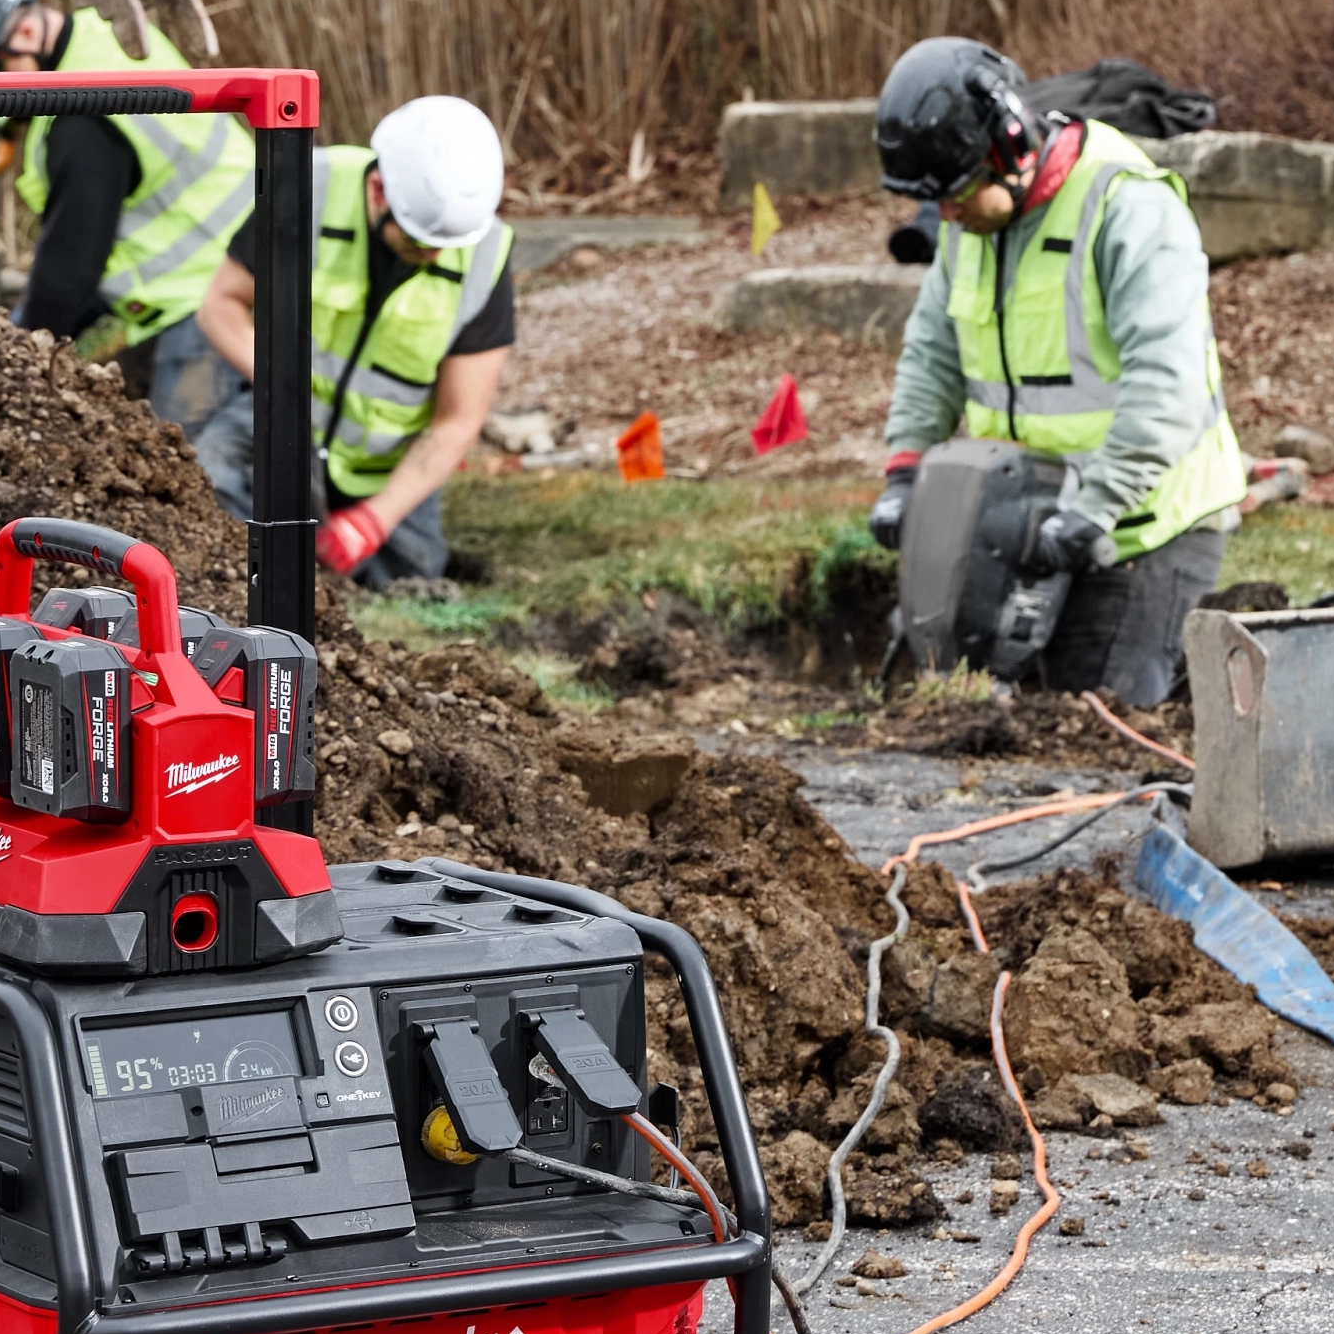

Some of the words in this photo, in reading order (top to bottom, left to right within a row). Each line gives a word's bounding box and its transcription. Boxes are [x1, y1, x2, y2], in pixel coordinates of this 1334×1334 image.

[106, 672, 114, 695] M18
[279, 669, 292, 735] FORGE
[92, 696, 104, 763] FORGE
[269, 735, 277, 758] M18
[164, 753, 240, 789] Milwaukee
[154, 845, 252, 865] PACKOUT
[571, 1056, 608, 1069] 20A
[168, 1063, 217, 1086] 03:03
[459, 1082, 495, 1097] 20A
[219, 1086, 285, 1122] Milwaukee
